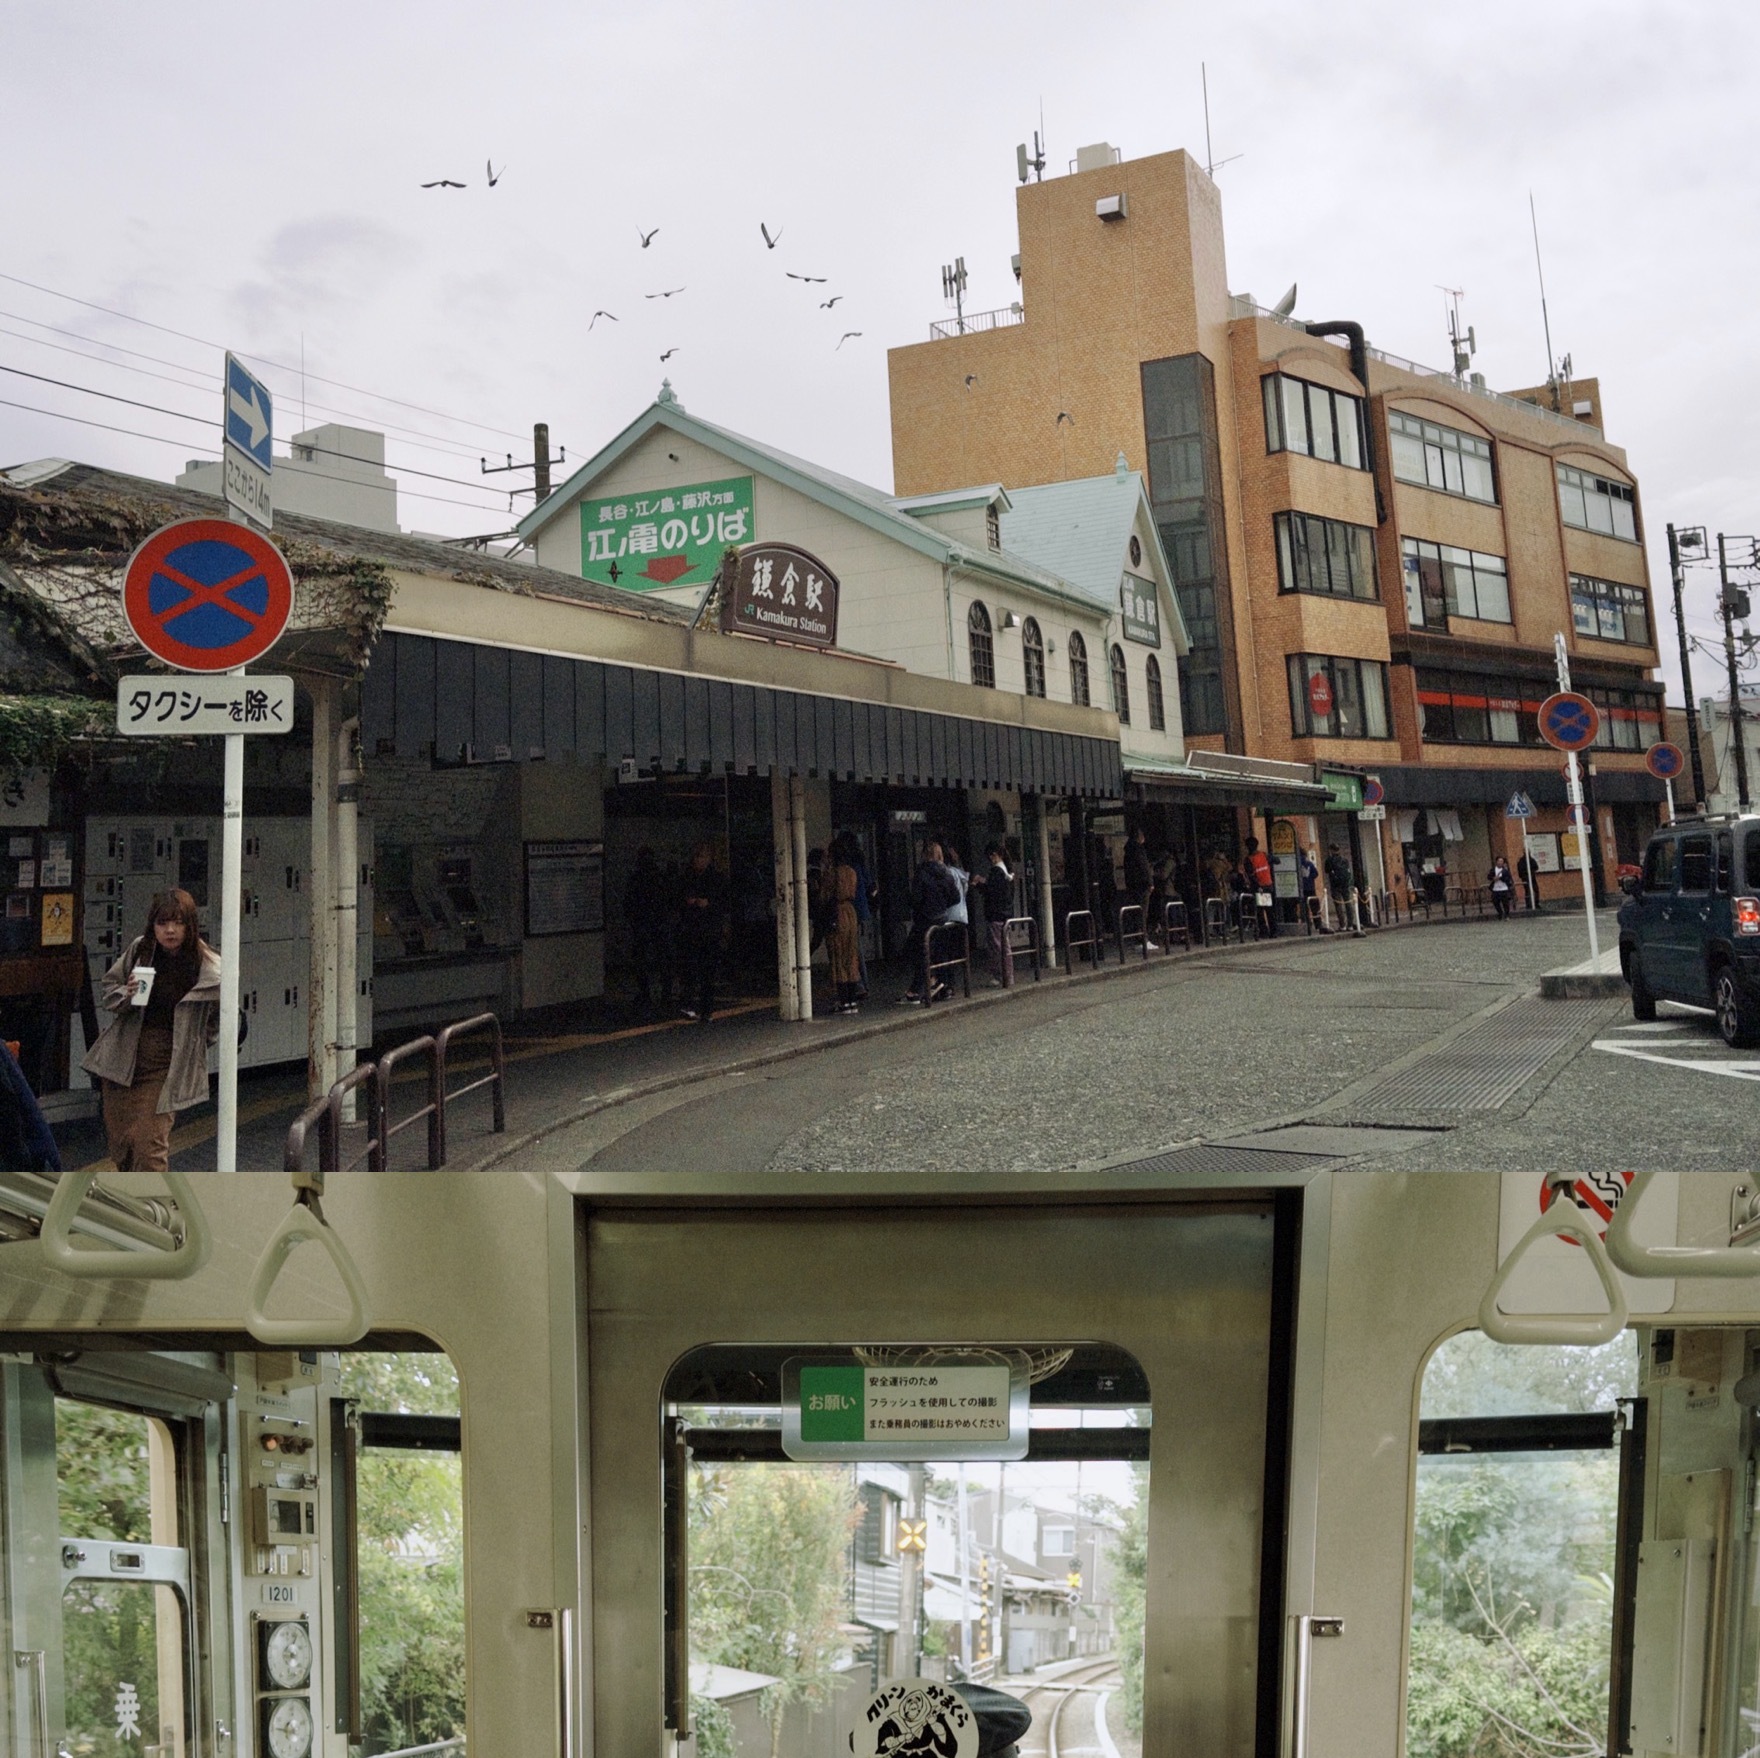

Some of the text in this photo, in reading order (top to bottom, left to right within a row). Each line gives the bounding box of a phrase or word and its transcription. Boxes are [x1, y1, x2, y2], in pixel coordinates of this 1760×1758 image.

[588, 507, 749, 562] 江ノ電のりば
[752, 557, 823, 612] 鎌倉駅
[744, 603, 827, 635] JR Kamakura Station
[129, 689, 284, 723] タクシーを除く
[869, 1376, 939, 1387] 安全運行のため
[808, 1393, 857, 1412] お願い
[869, 1397, 998, 1408] フラッシュを使用しての撮影
[869, 1418, 1006, 1430] また乗務員の撮影はおやめください
[269, 1586, 293, 1602] 1201
[866, 1686, 906, 1723] クリーン
[926, 1685, 969, 1728] かまくら
